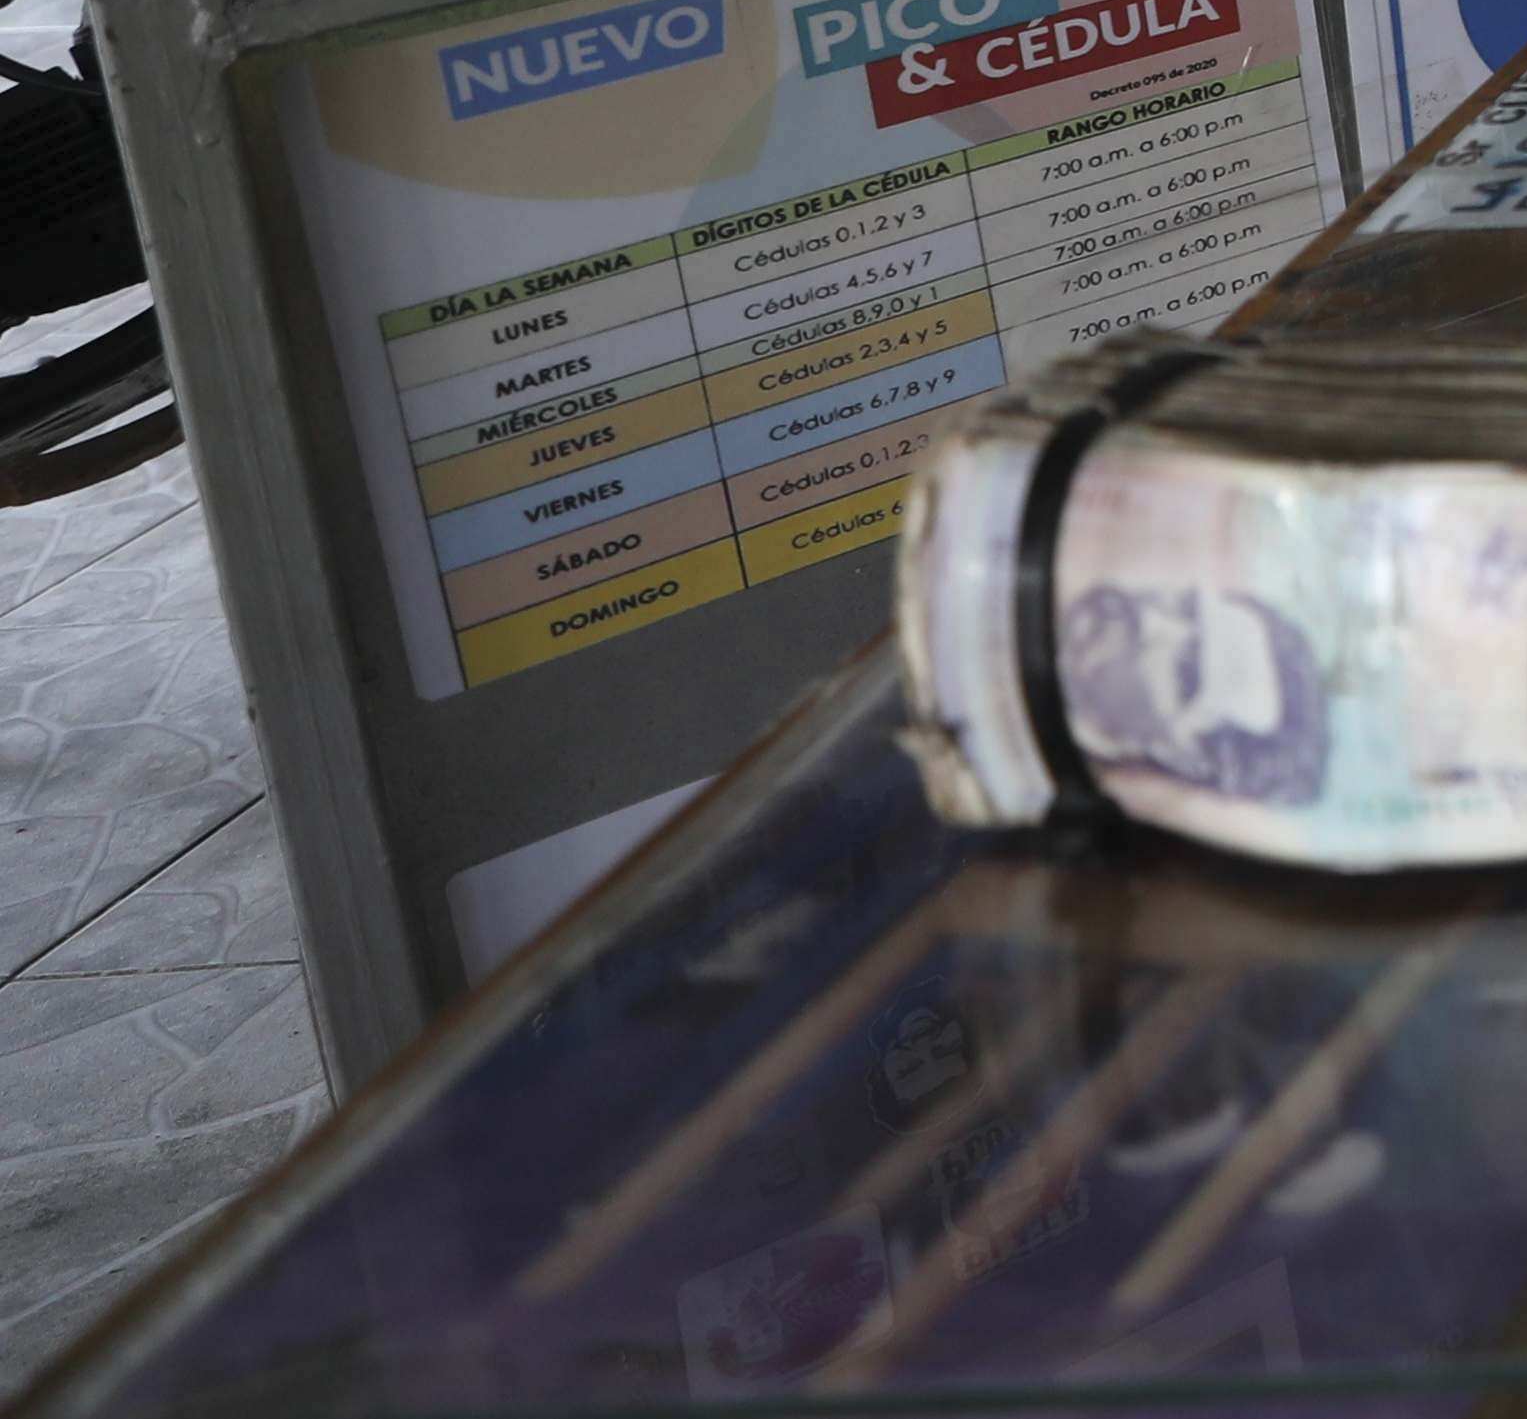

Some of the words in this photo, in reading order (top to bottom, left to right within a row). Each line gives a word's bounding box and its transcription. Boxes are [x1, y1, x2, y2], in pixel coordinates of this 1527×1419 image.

[451, 2, 714, 105] NUEVO
[896, 41, 955, 96] &
[492, 309, 569, 345] LUNES
[494, 355, 592, 399] MARTES
[476, 385, 618, 447] MIÉRCOLES
[528, 425, 617, 468] JUEVES
[523, 478, 625, 526] VIERNES
[535, 532, 643, 583] SÁBADO
[548, 579, 681, 639] DOMINGO
